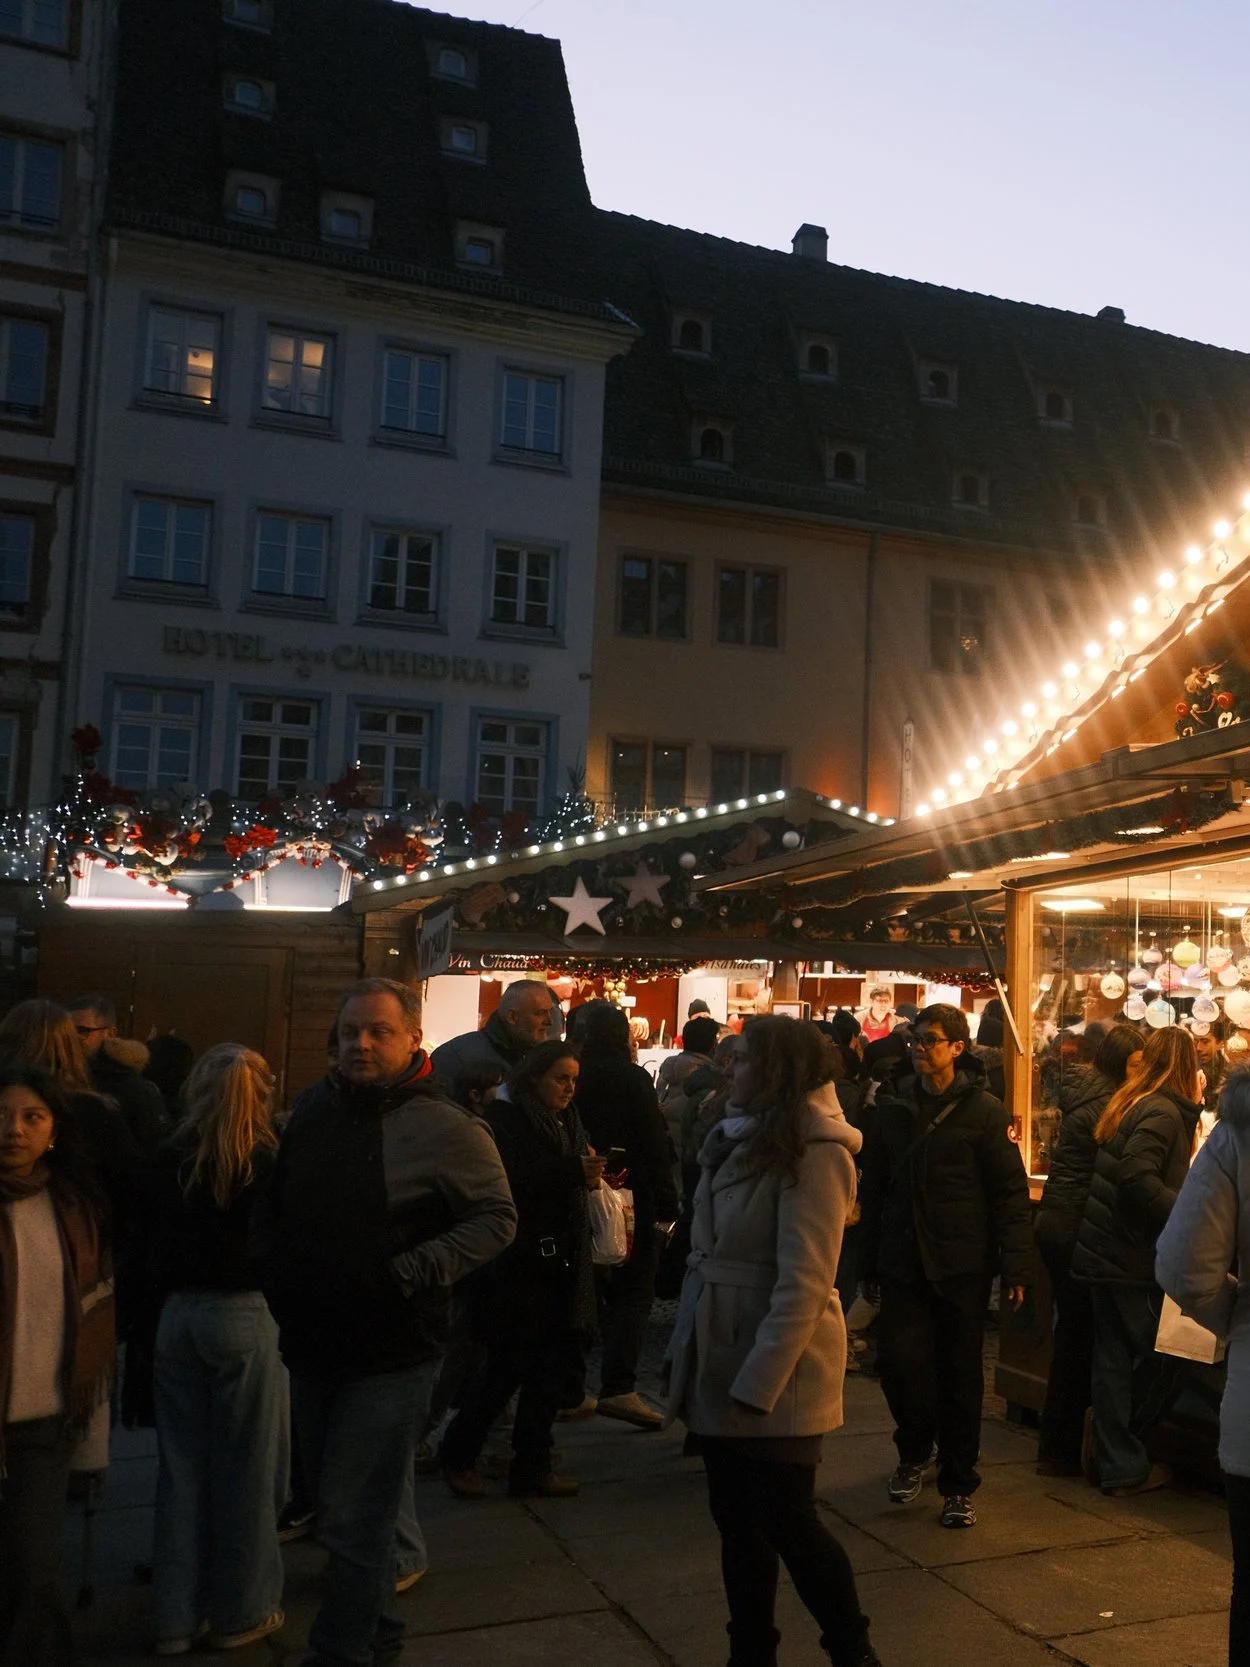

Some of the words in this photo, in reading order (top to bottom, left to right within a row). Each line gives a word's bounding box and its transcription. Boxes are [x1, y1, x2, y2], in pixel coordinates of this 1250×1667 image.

[162, 625, 275, 663] HOTEL
[331, 643, 531, 688] CATHEDRALE
[448, 952, 471, 968] Vin
[480, 953, 529, 968] Chaud
